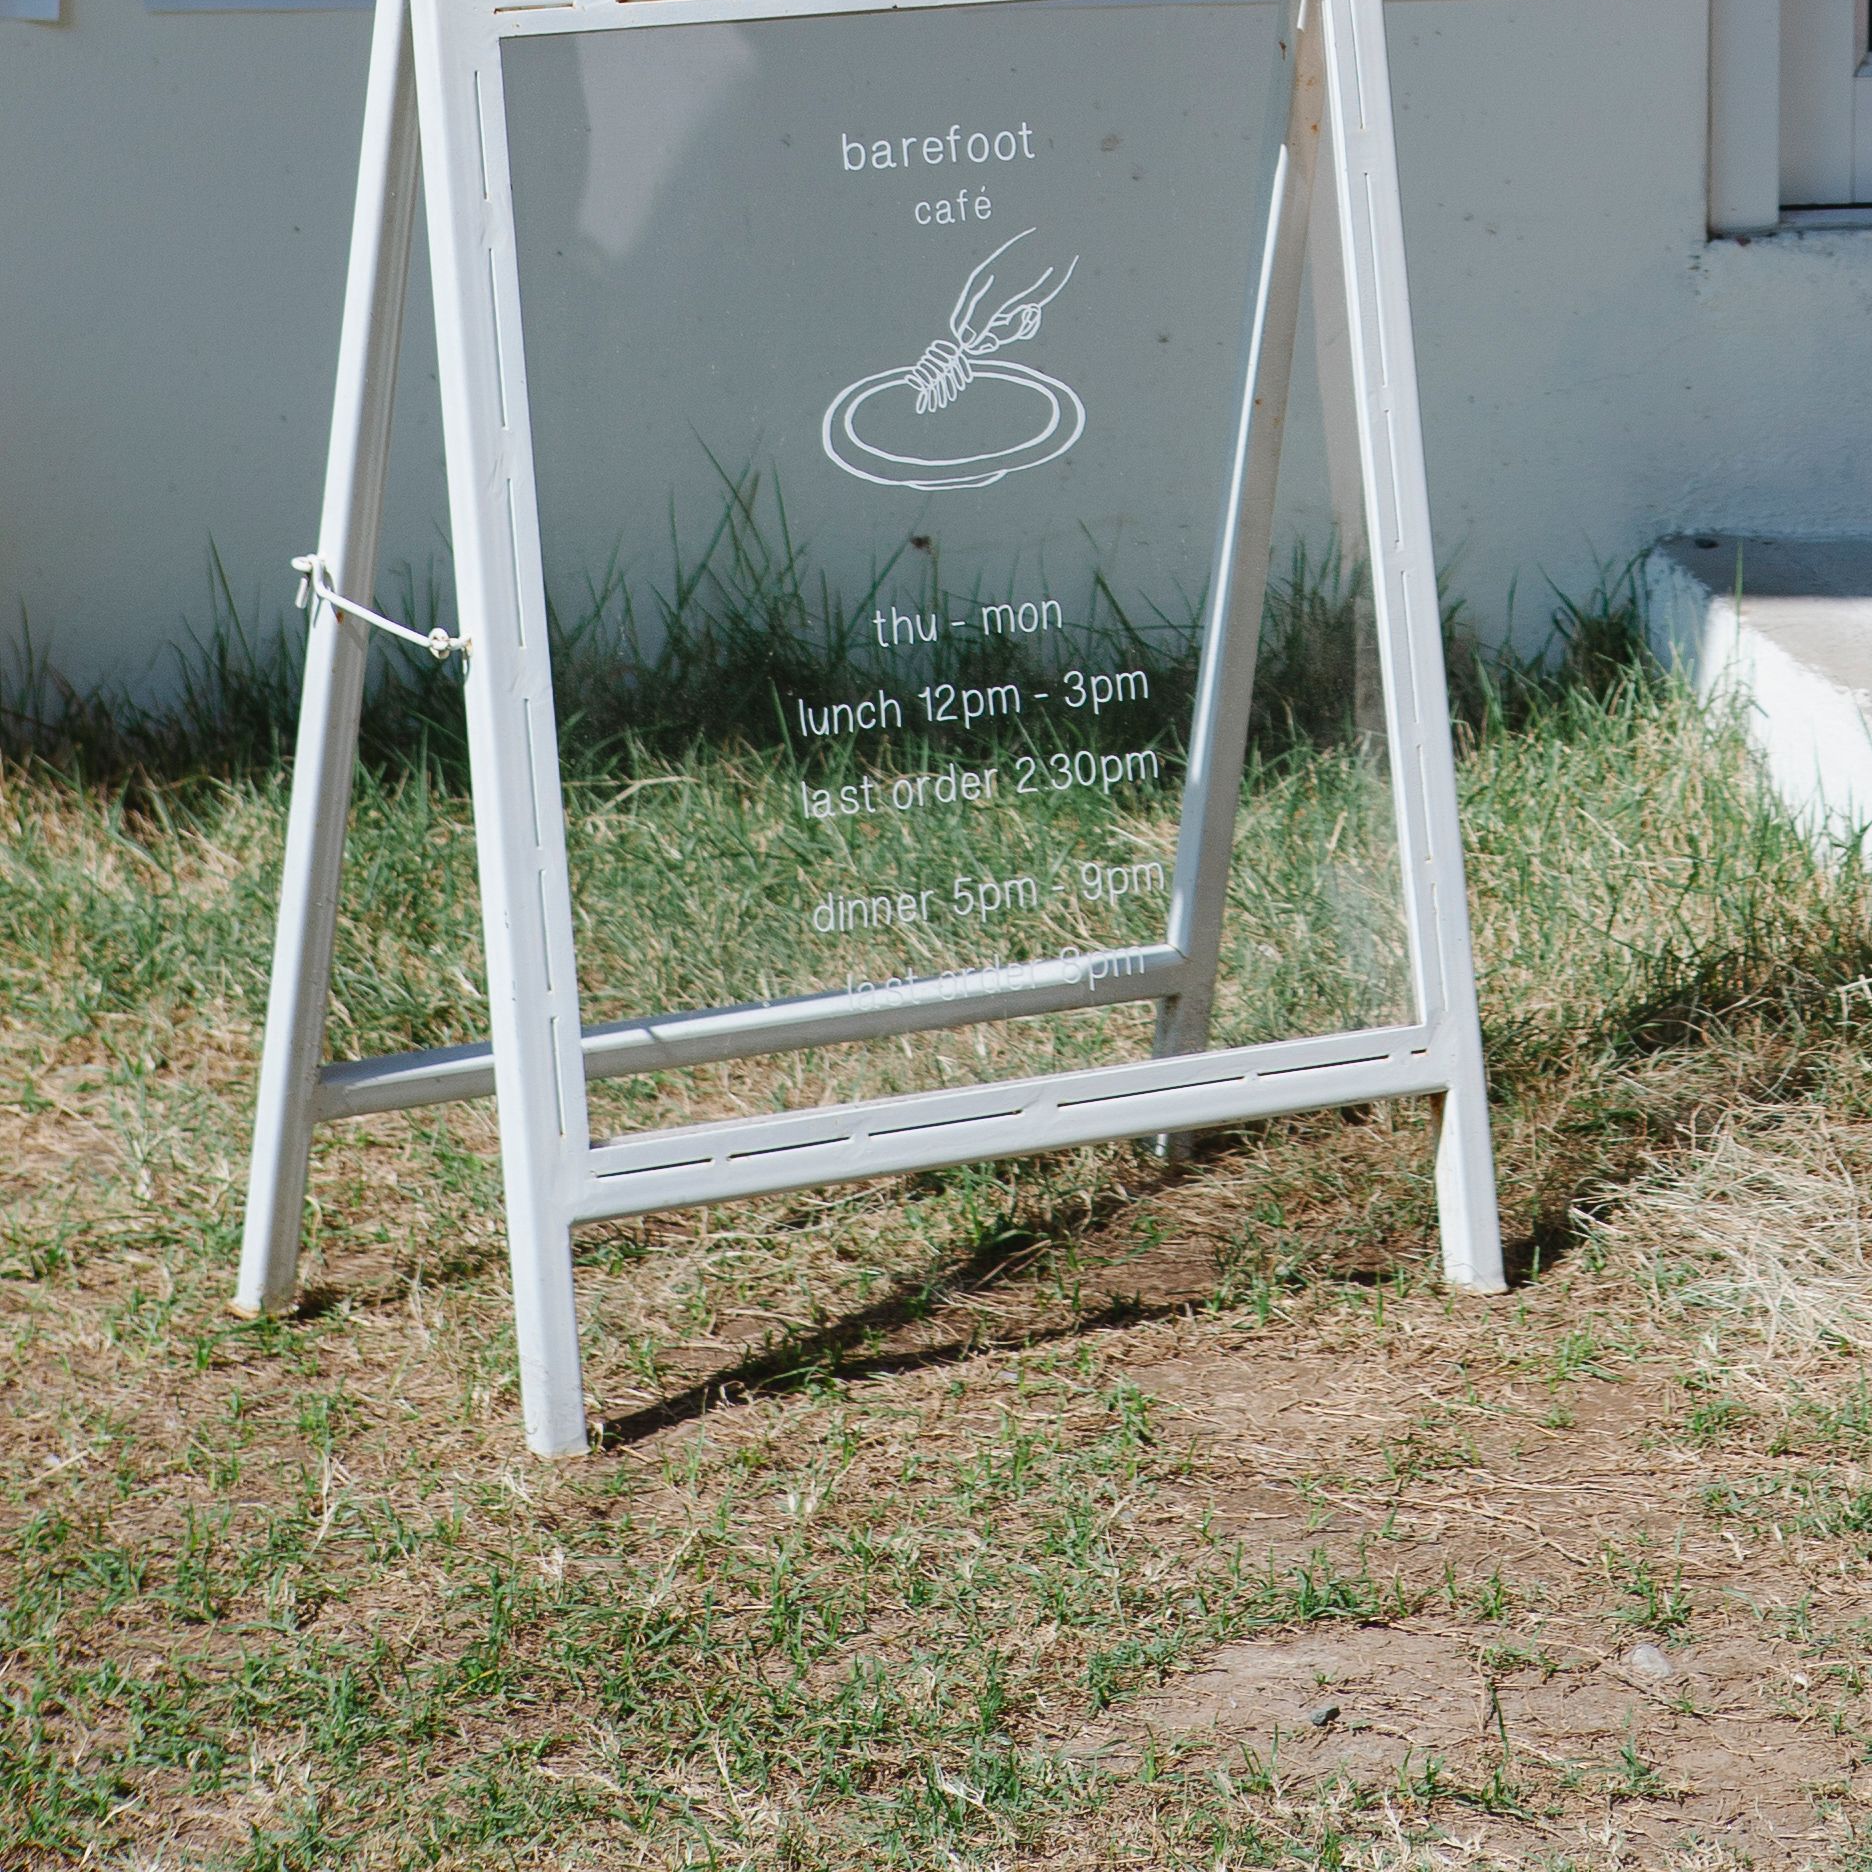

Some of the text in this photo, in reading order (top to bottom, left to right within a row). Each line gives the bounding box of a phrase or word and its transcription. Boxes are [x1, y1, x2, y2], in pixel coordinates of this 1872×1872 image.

[841, 121, 1036, 173] barefoot
[914, 184, 993, 227] café
[873, 608, 937, 648] thu
[983, 598, 1063, 636] mon
[798, 690, 901, 736] lunch
[919, 683, 1021, 728] 12pm
[1063, 669, 1149, 715] 3pm
[801, 748, 1159, 819] last order 2.30pm
[813, 888, 934, 933] dinner
[953, 875, 1037, 922] 5pm
[1082, 860, 1165, 906] 9pm
[846, 944, 1145, 1013] last order 8pm
